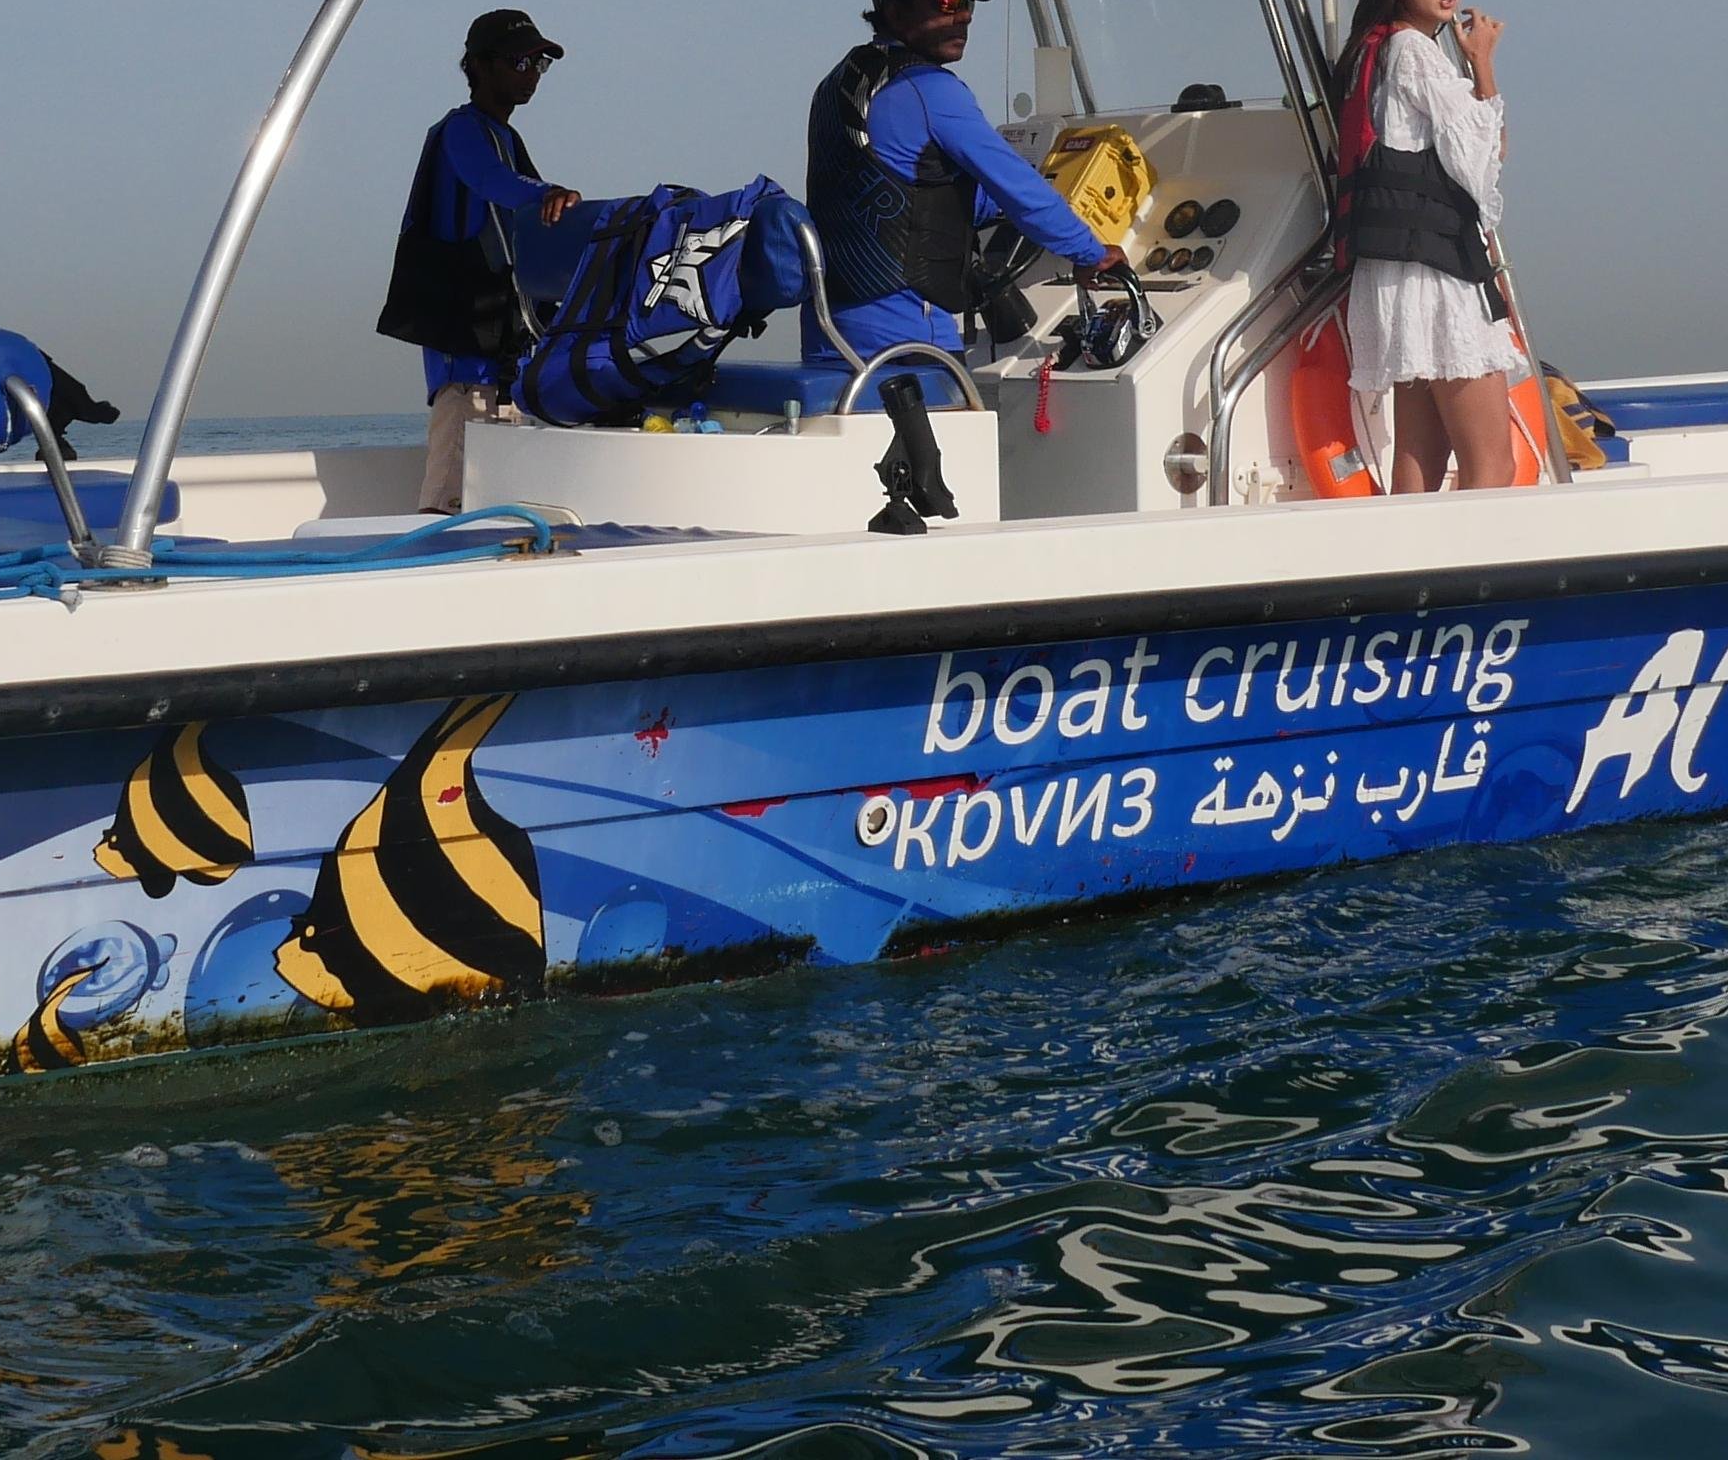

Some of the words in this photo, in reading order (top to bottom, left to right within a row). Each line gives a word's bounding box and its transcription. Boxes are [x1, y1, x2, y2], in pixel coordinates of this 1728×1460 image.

[923, 637, 1160, 754] boat
[1184, 609, 1529, 713] cruising
[1190, 750, 1339, 842] نزهة
[1355, 720, 1491, 824] قارب
